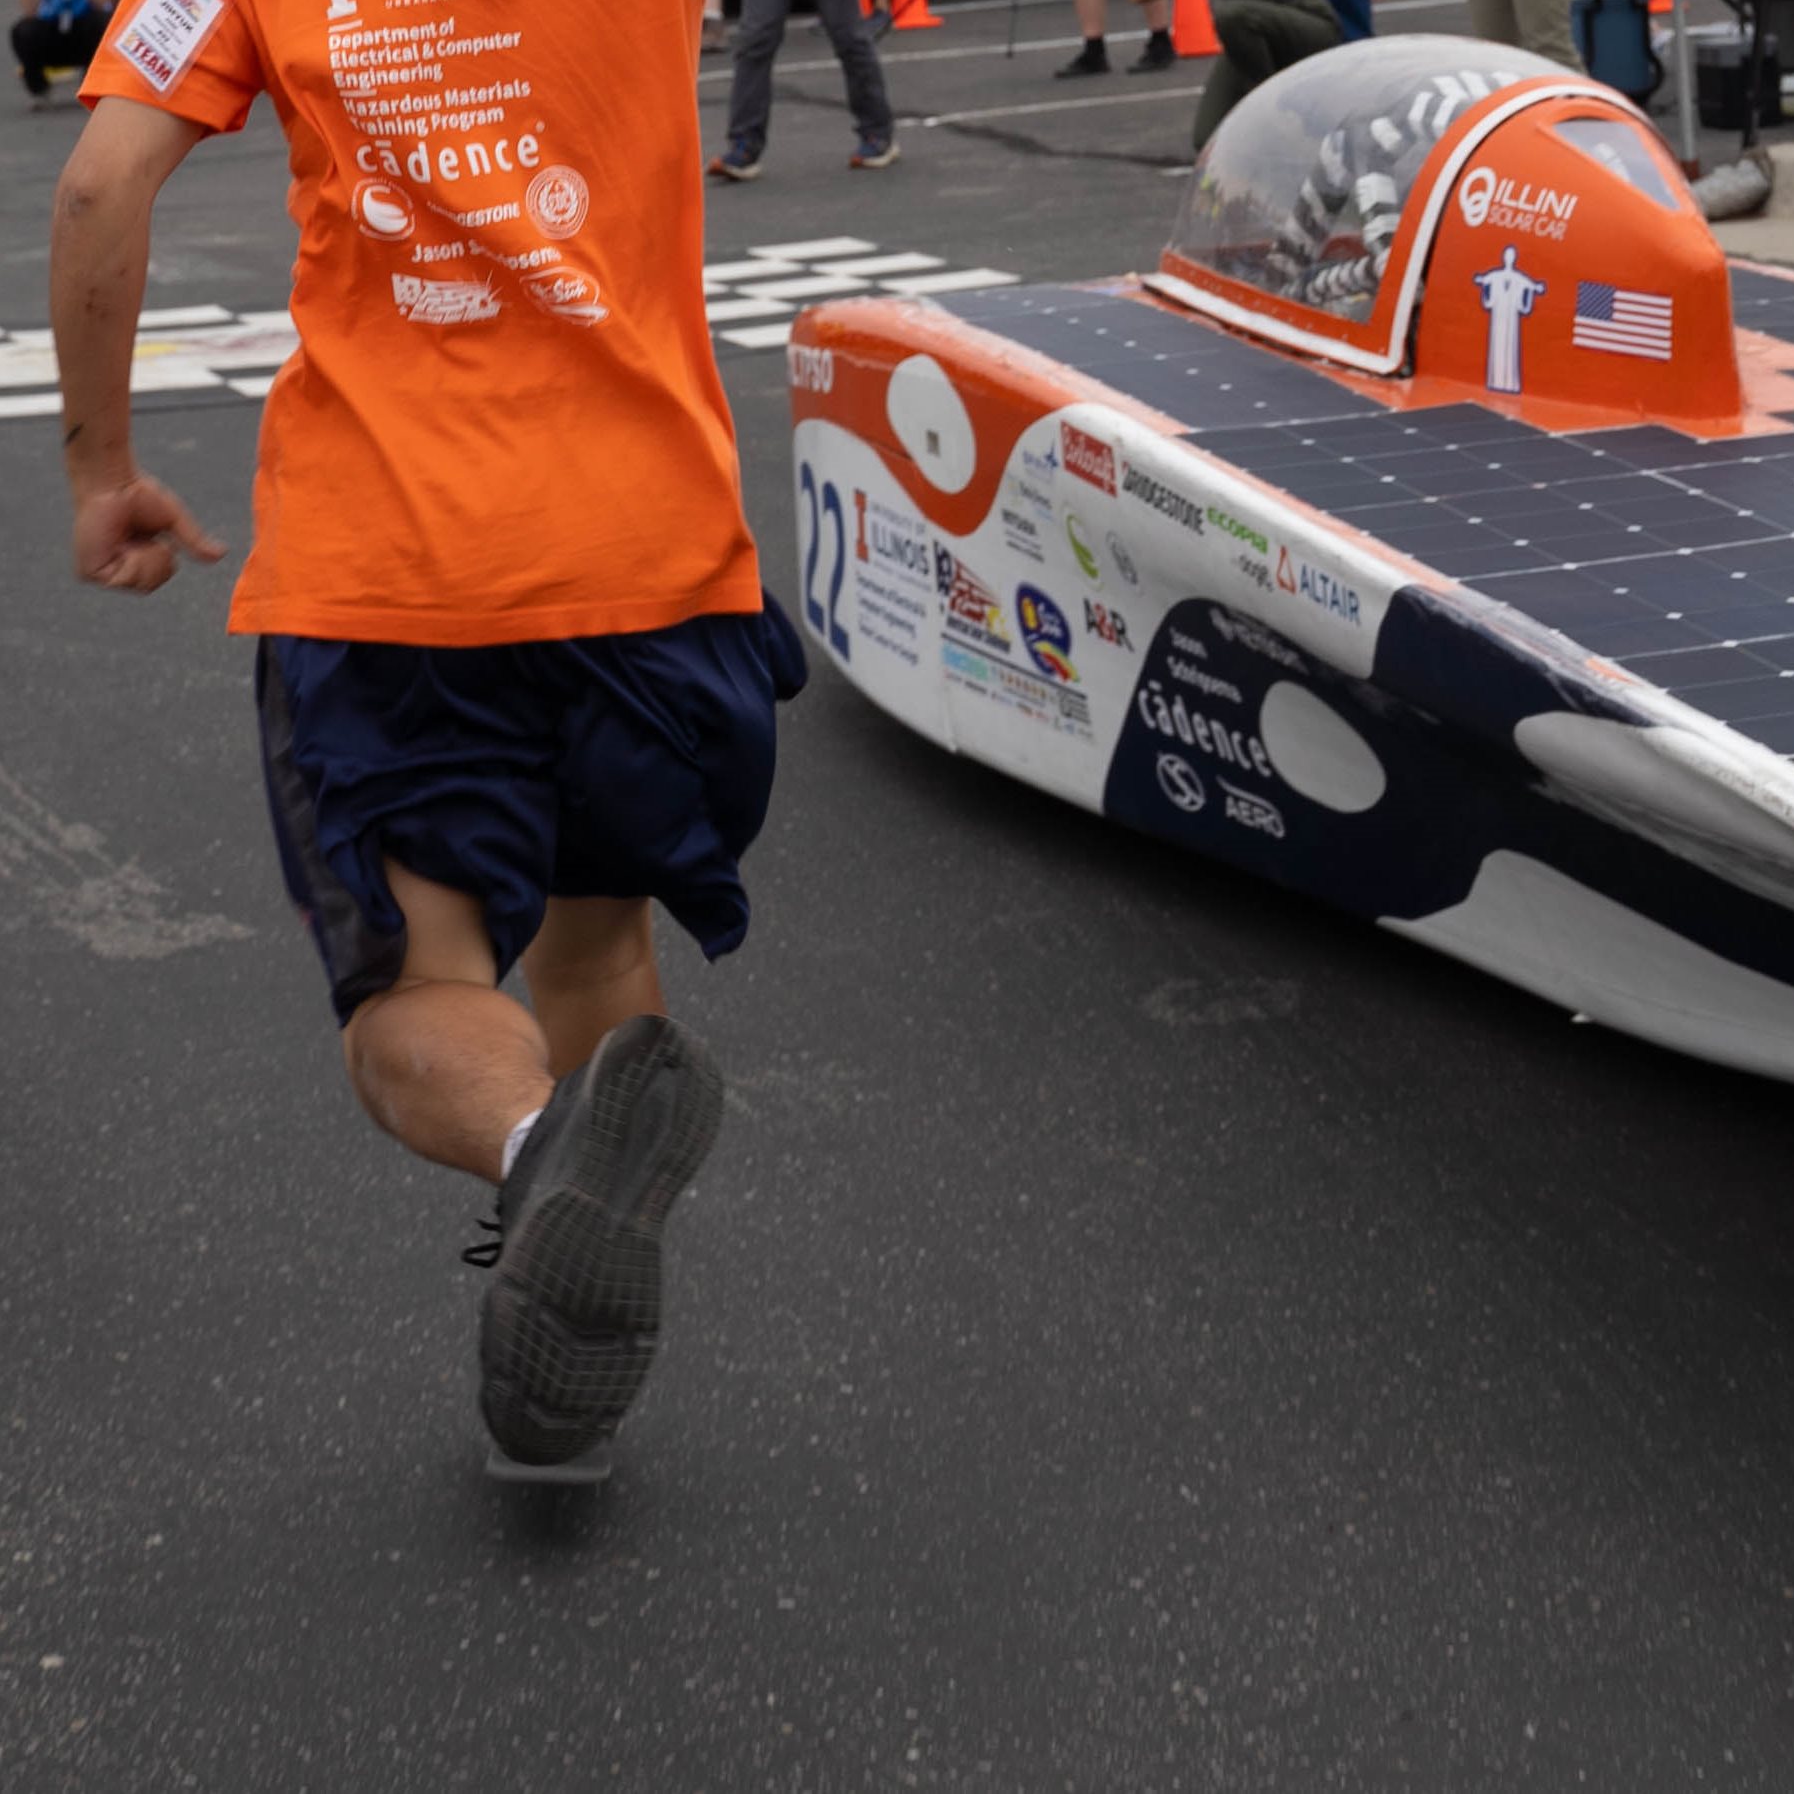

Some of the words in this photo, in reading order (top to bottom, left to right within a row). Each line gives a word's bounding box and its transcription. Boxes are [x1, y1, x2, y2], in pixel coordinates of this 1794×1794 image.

[328, 22, 436, 52] Department
[438, 17, 455, 37] of
[329, 44, 420, 69] Electrical
[422, 41, 435, 60] &
[436, 31, 522, 58] Computer
[333, 62, 444, 91] Engineering
[343, 93, 442, 118] Hazardous
[444, 79, 531, 108] Materials
[431, 105, 505, 132] Program
[1493, 177, 1579, 220] ILLINI
[1487, 205, 1536, 233] SOLAR
[1534, 215, 1568, 242] CAR
[411, 240, 465, 264] Jason
[800, 460, 850, 664] 22
[1299, 563, 1362, 628] ALTAIR
